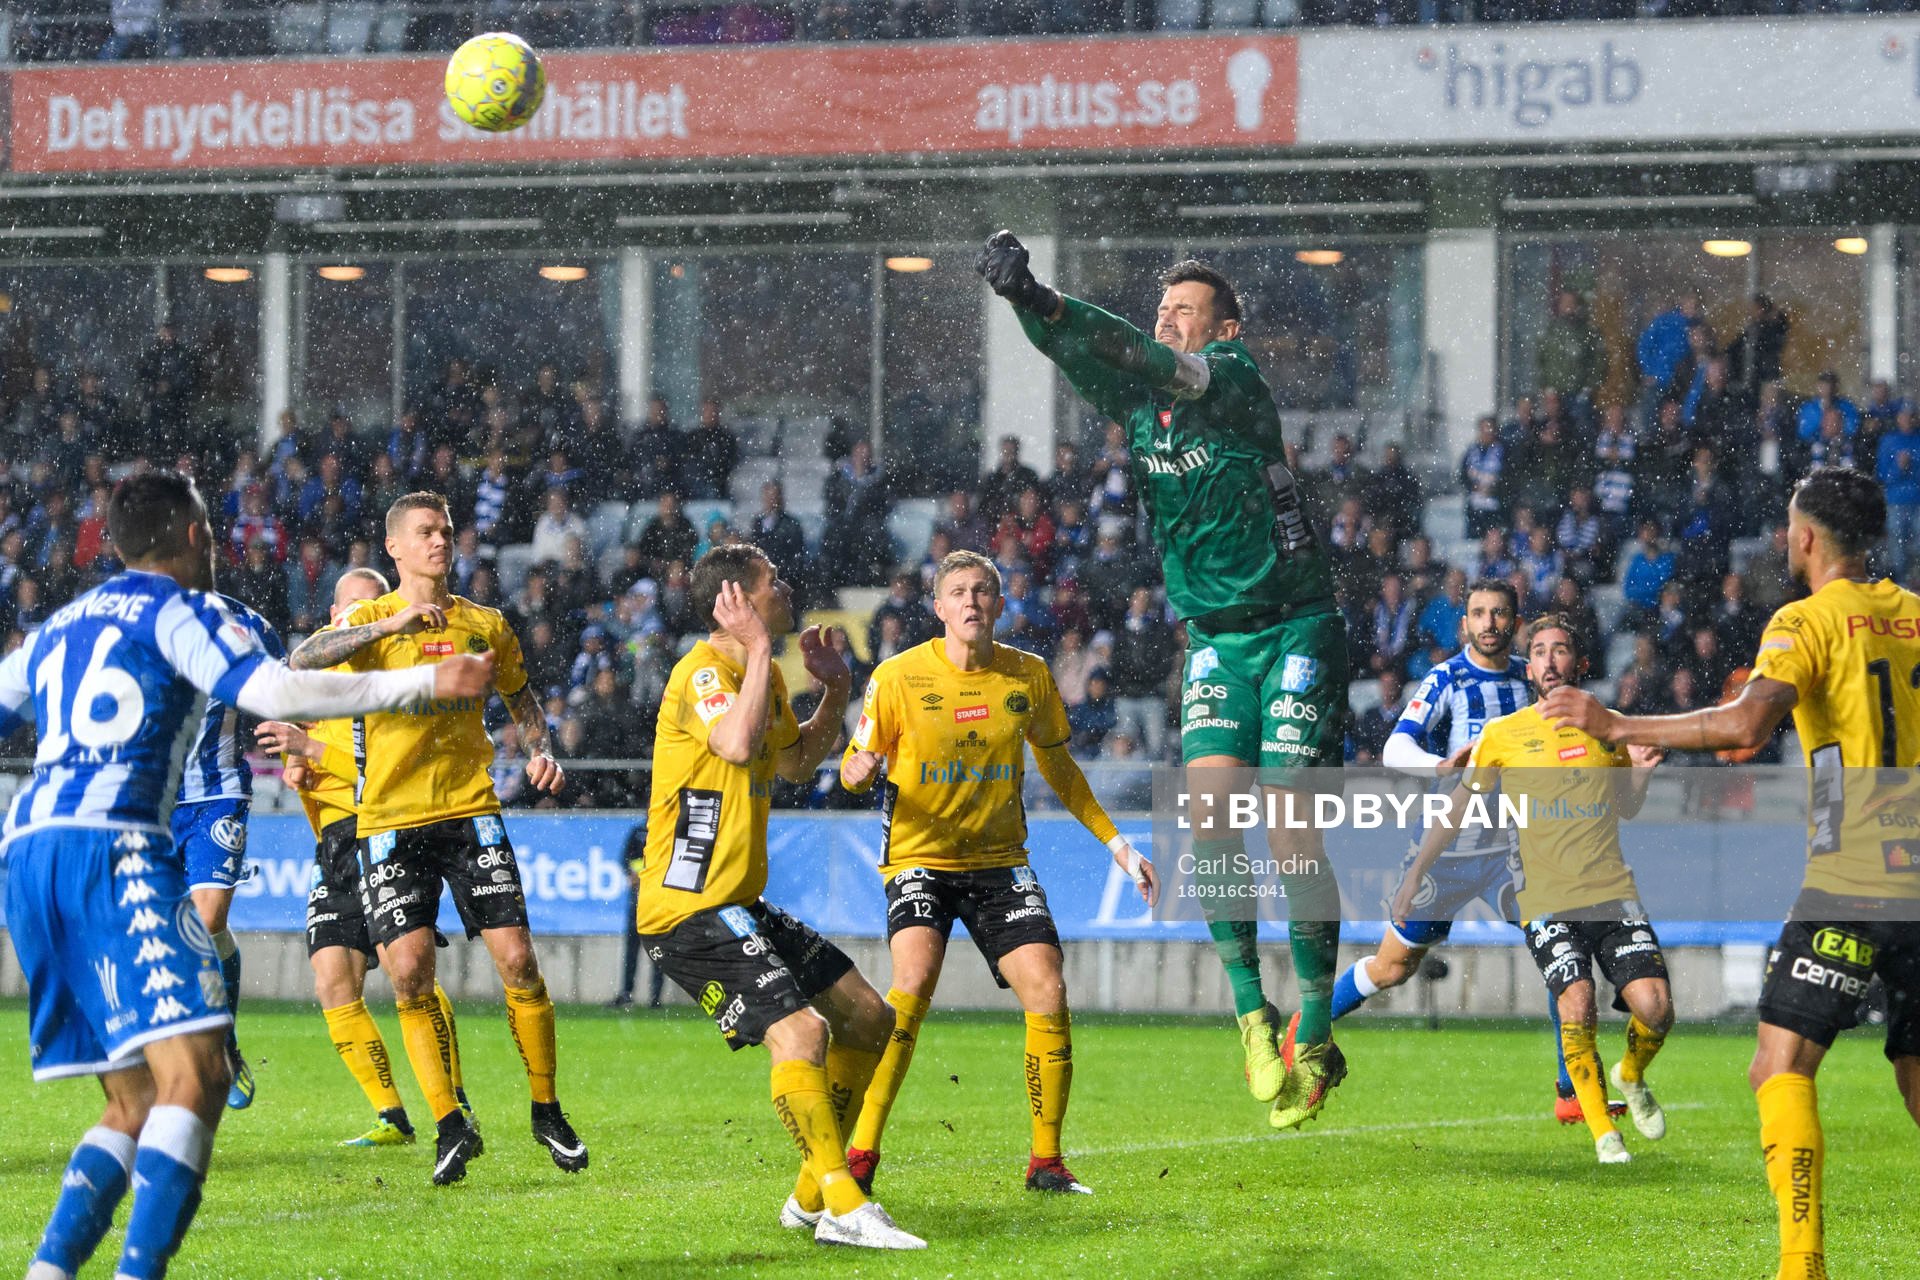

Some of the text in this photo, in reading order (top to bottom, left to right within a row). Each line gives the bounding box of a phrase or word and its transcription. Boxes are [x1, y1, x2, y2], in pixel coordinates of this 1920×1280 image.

[1443, 42, 1642, 126] higab
[47, 79, 688, 160] Det nyckellösa shället
[975, 73, 1197, 142] aptus.se
[1847, 615, 1920, 639] PULS
[33, 625, 145, 768] 16
[1183, 680, 1228, 705] ellos
[956, 707, 987, 720] STAPLES
[1270, 695, 1318, 722] ellos
[369, 863, 406, 888] ellos
[392, 909, 407, 926] 8
[912, 901, 933, 919] 12
[1535, 922, 1569, 949] ellos
[1819, 931, 1873, 967] EAB
[1558, 960, 1580, 983] 27
[365, 1039, 393, 1089] FRISTADS
[1026, 1052, 1043, 1118] FRISTADS
[1792, 1146, 1814, 1224] FRISTADS
